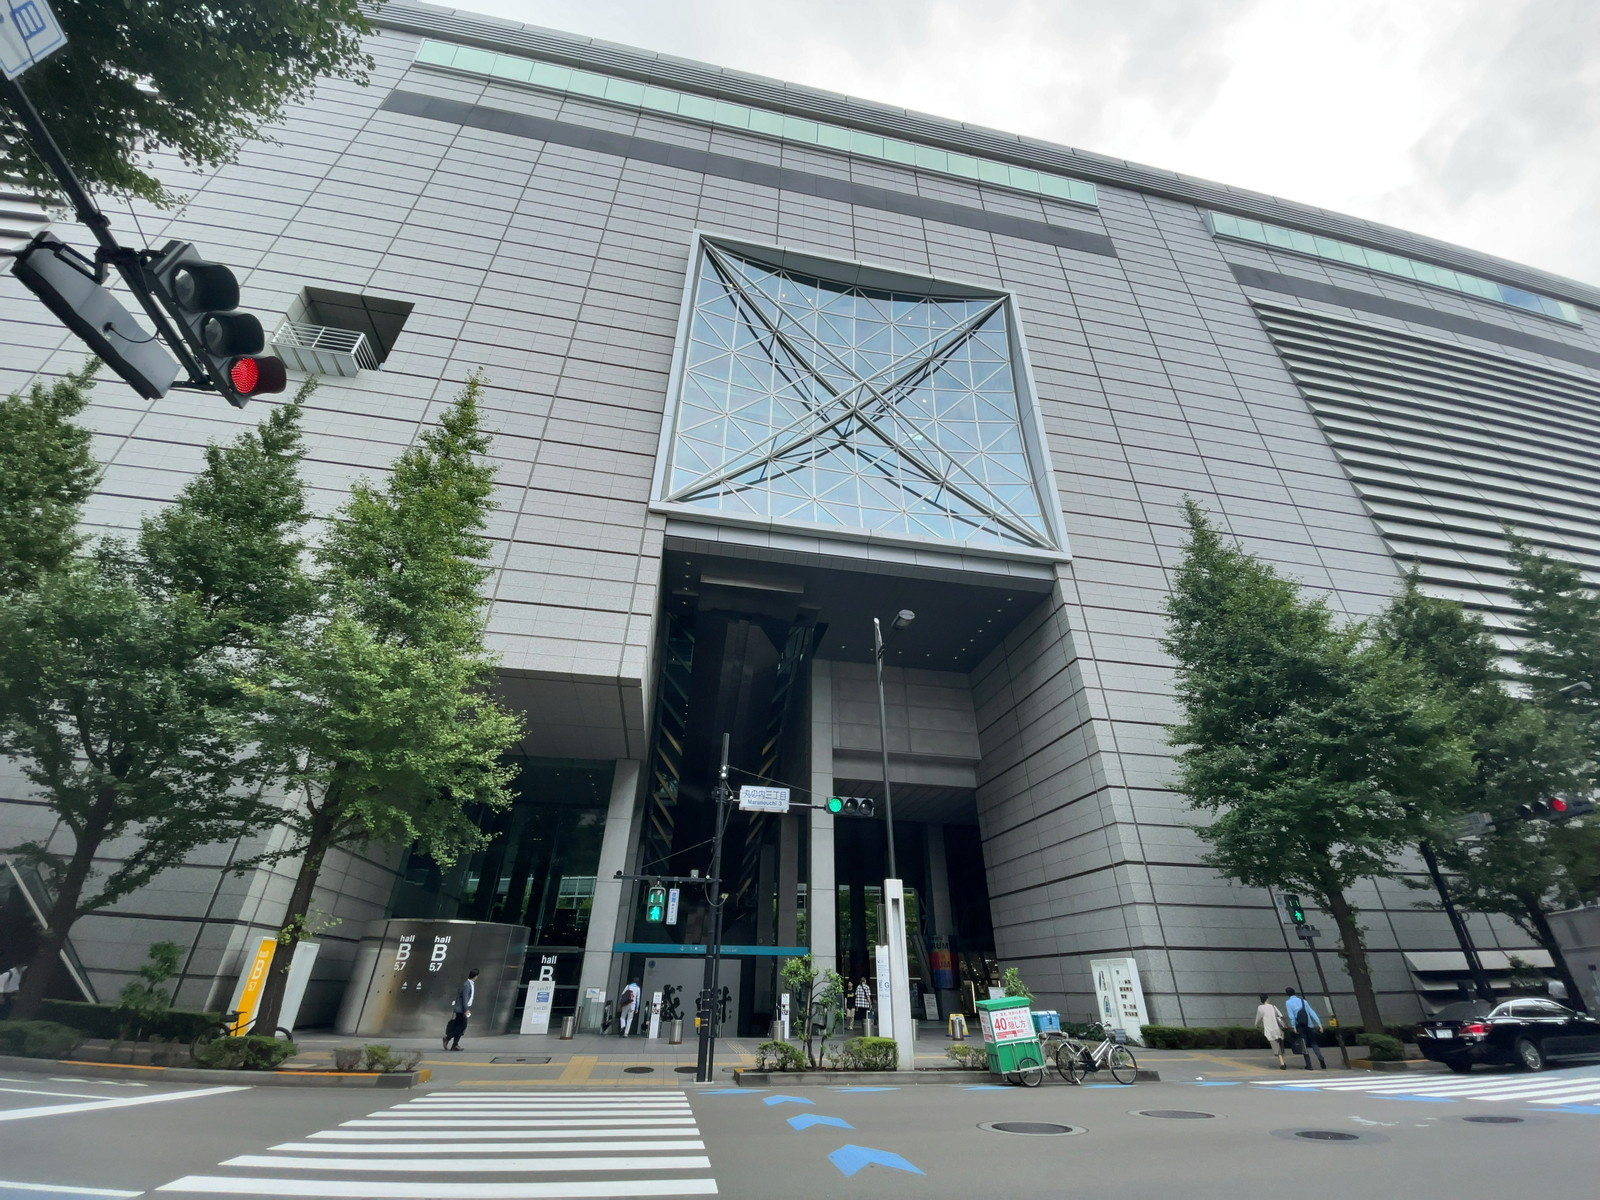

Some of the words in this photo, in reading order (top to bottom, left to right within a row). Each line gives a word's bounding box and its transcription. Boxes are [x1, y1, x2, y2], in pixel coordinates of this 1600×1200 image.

[743, 789, 787, 801] 丸の内三丁目
[399, 934, 416, 942] hall
[434, 935, 451, 943] hall
[395, 943, 411, 961] B
[430, 944, 448, 962] B
[541, 954, 558, 964] hall
[251, 959, 265, 980] B
[393, 961, 407, 971] 5,7
[428, 962, 443, 972] 5,7
[538, 965, 554, 982] B
[994, 1017, 1007, 1031] 40
